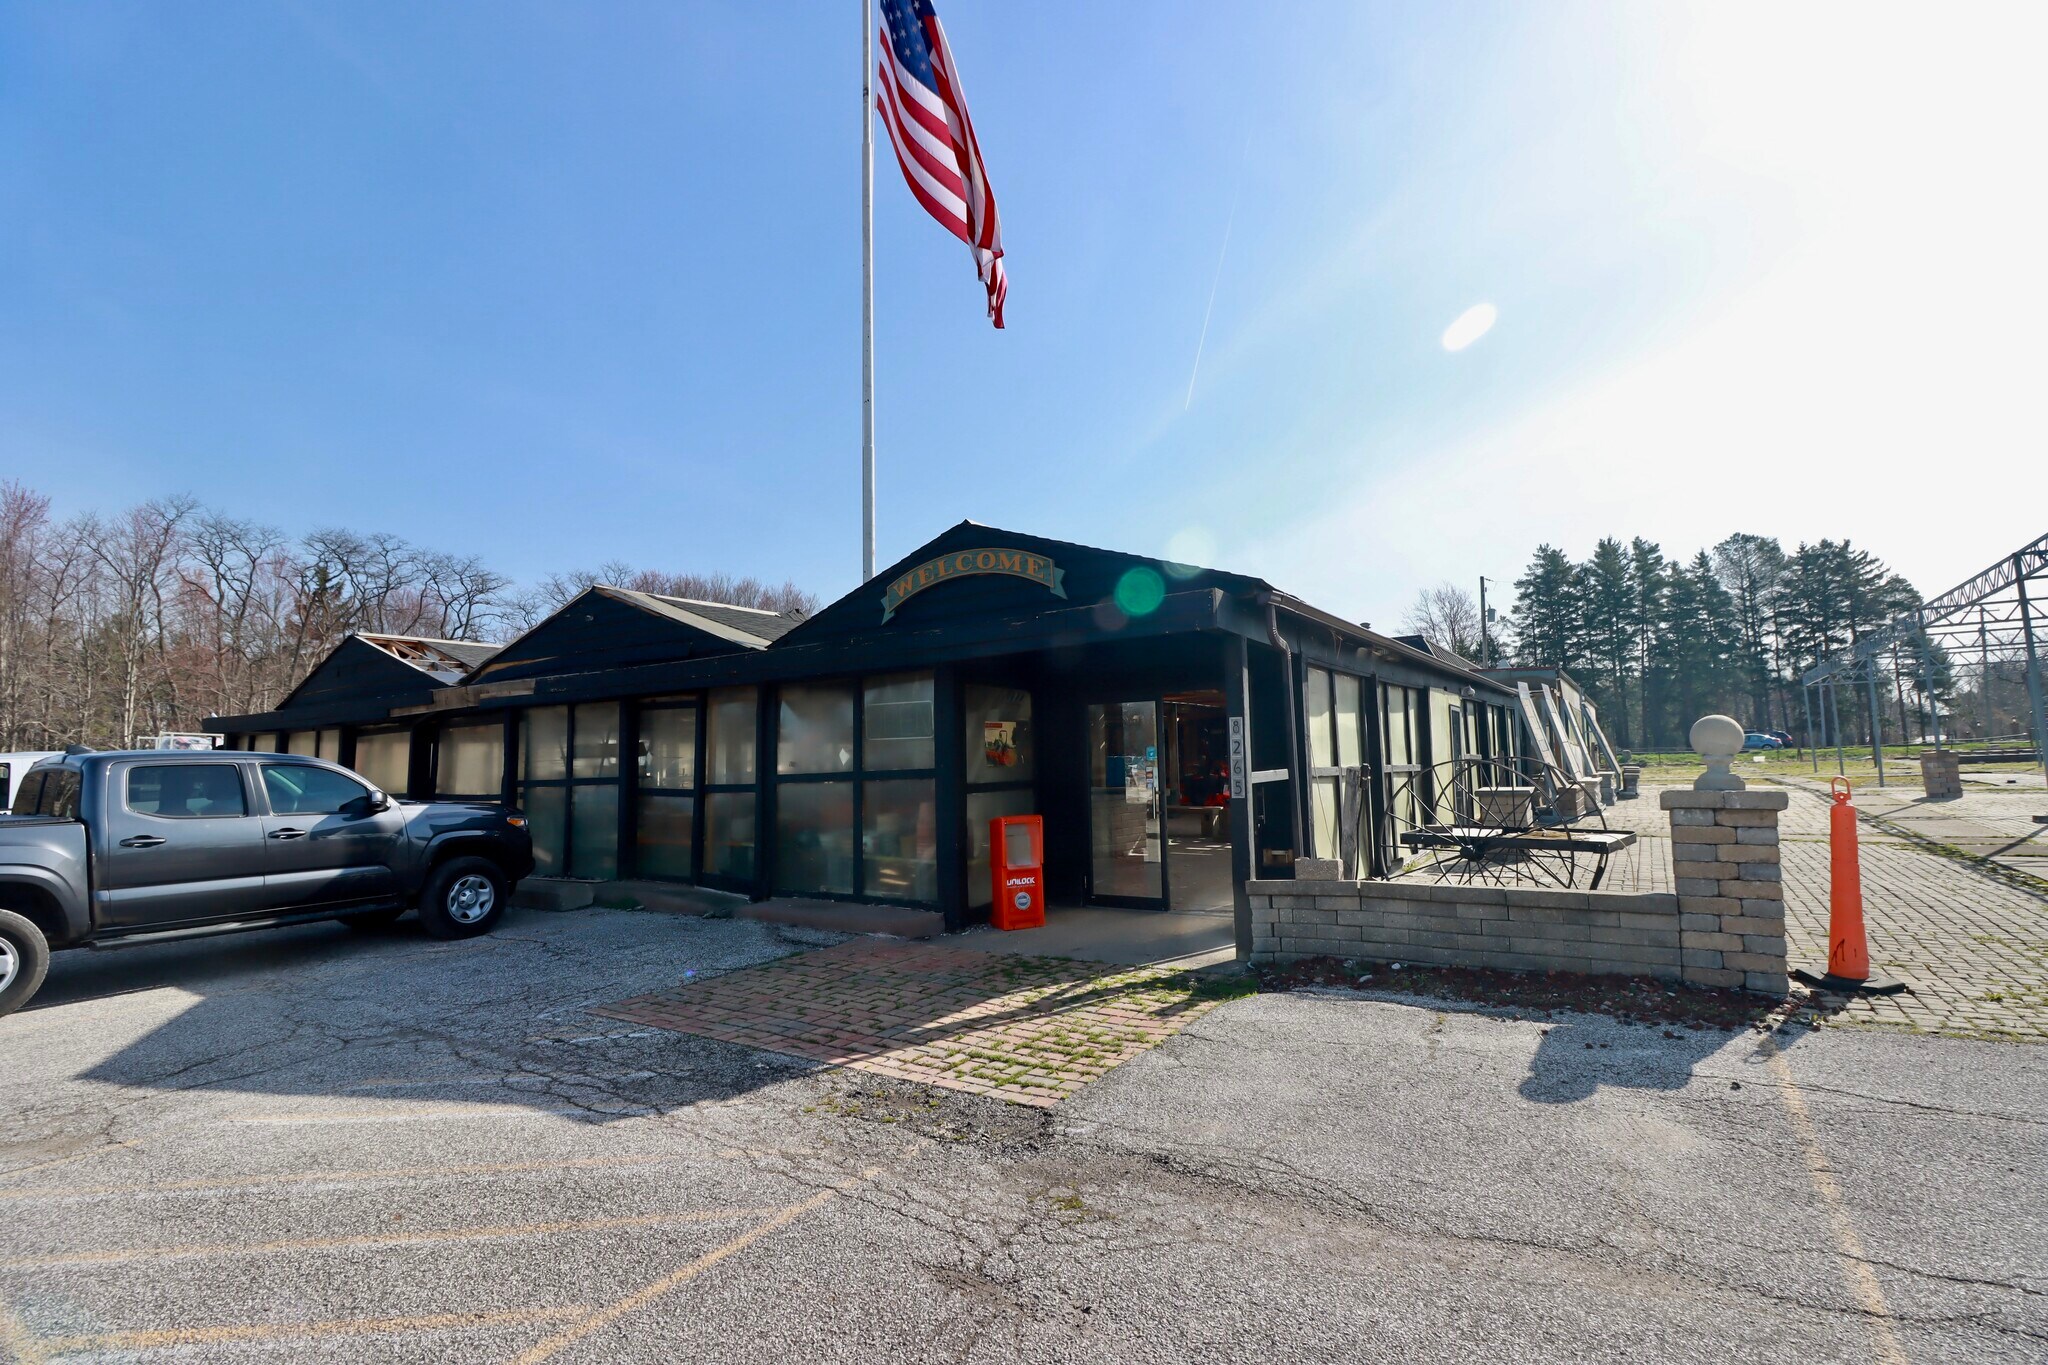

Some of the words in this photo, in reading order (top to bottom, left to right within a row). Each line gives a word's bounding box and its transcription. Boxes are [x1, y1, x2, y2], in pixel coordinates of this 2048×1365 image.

[893, 552, 1045, 597] WELCOME
[1231, 719, 1243, 796] 8265
[1006, 876, 1036, 886] UNILOCK
